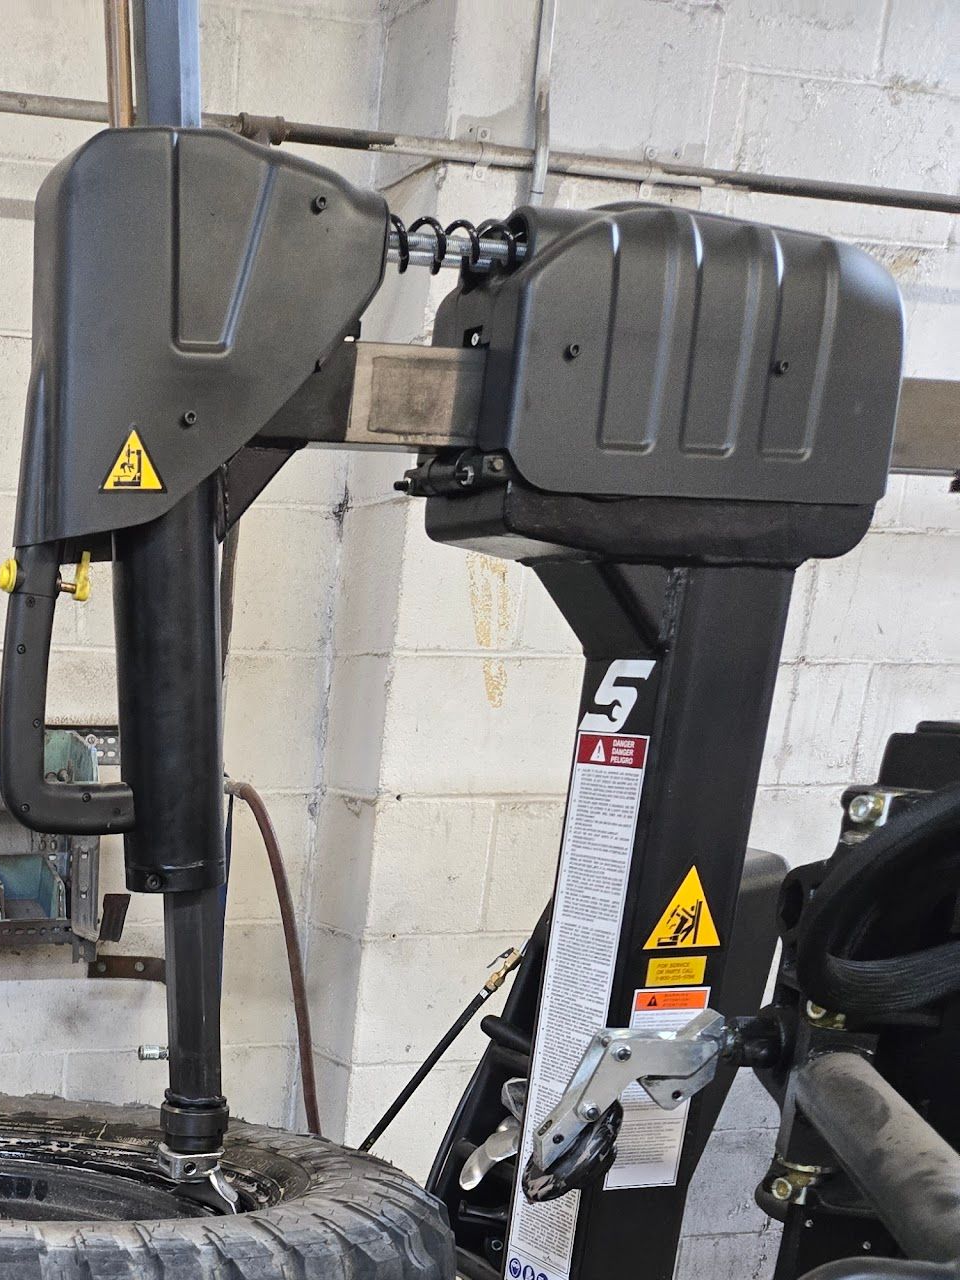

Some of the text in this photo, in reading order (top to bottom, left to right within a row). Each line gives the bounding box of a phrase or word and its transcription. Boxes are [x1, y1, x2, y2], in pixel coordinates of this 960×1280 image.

[612, 739, 635, 749] DANGER
[611, 748, 634, 757] DANGER
[610, 756, 633, 765] PELIGRO
